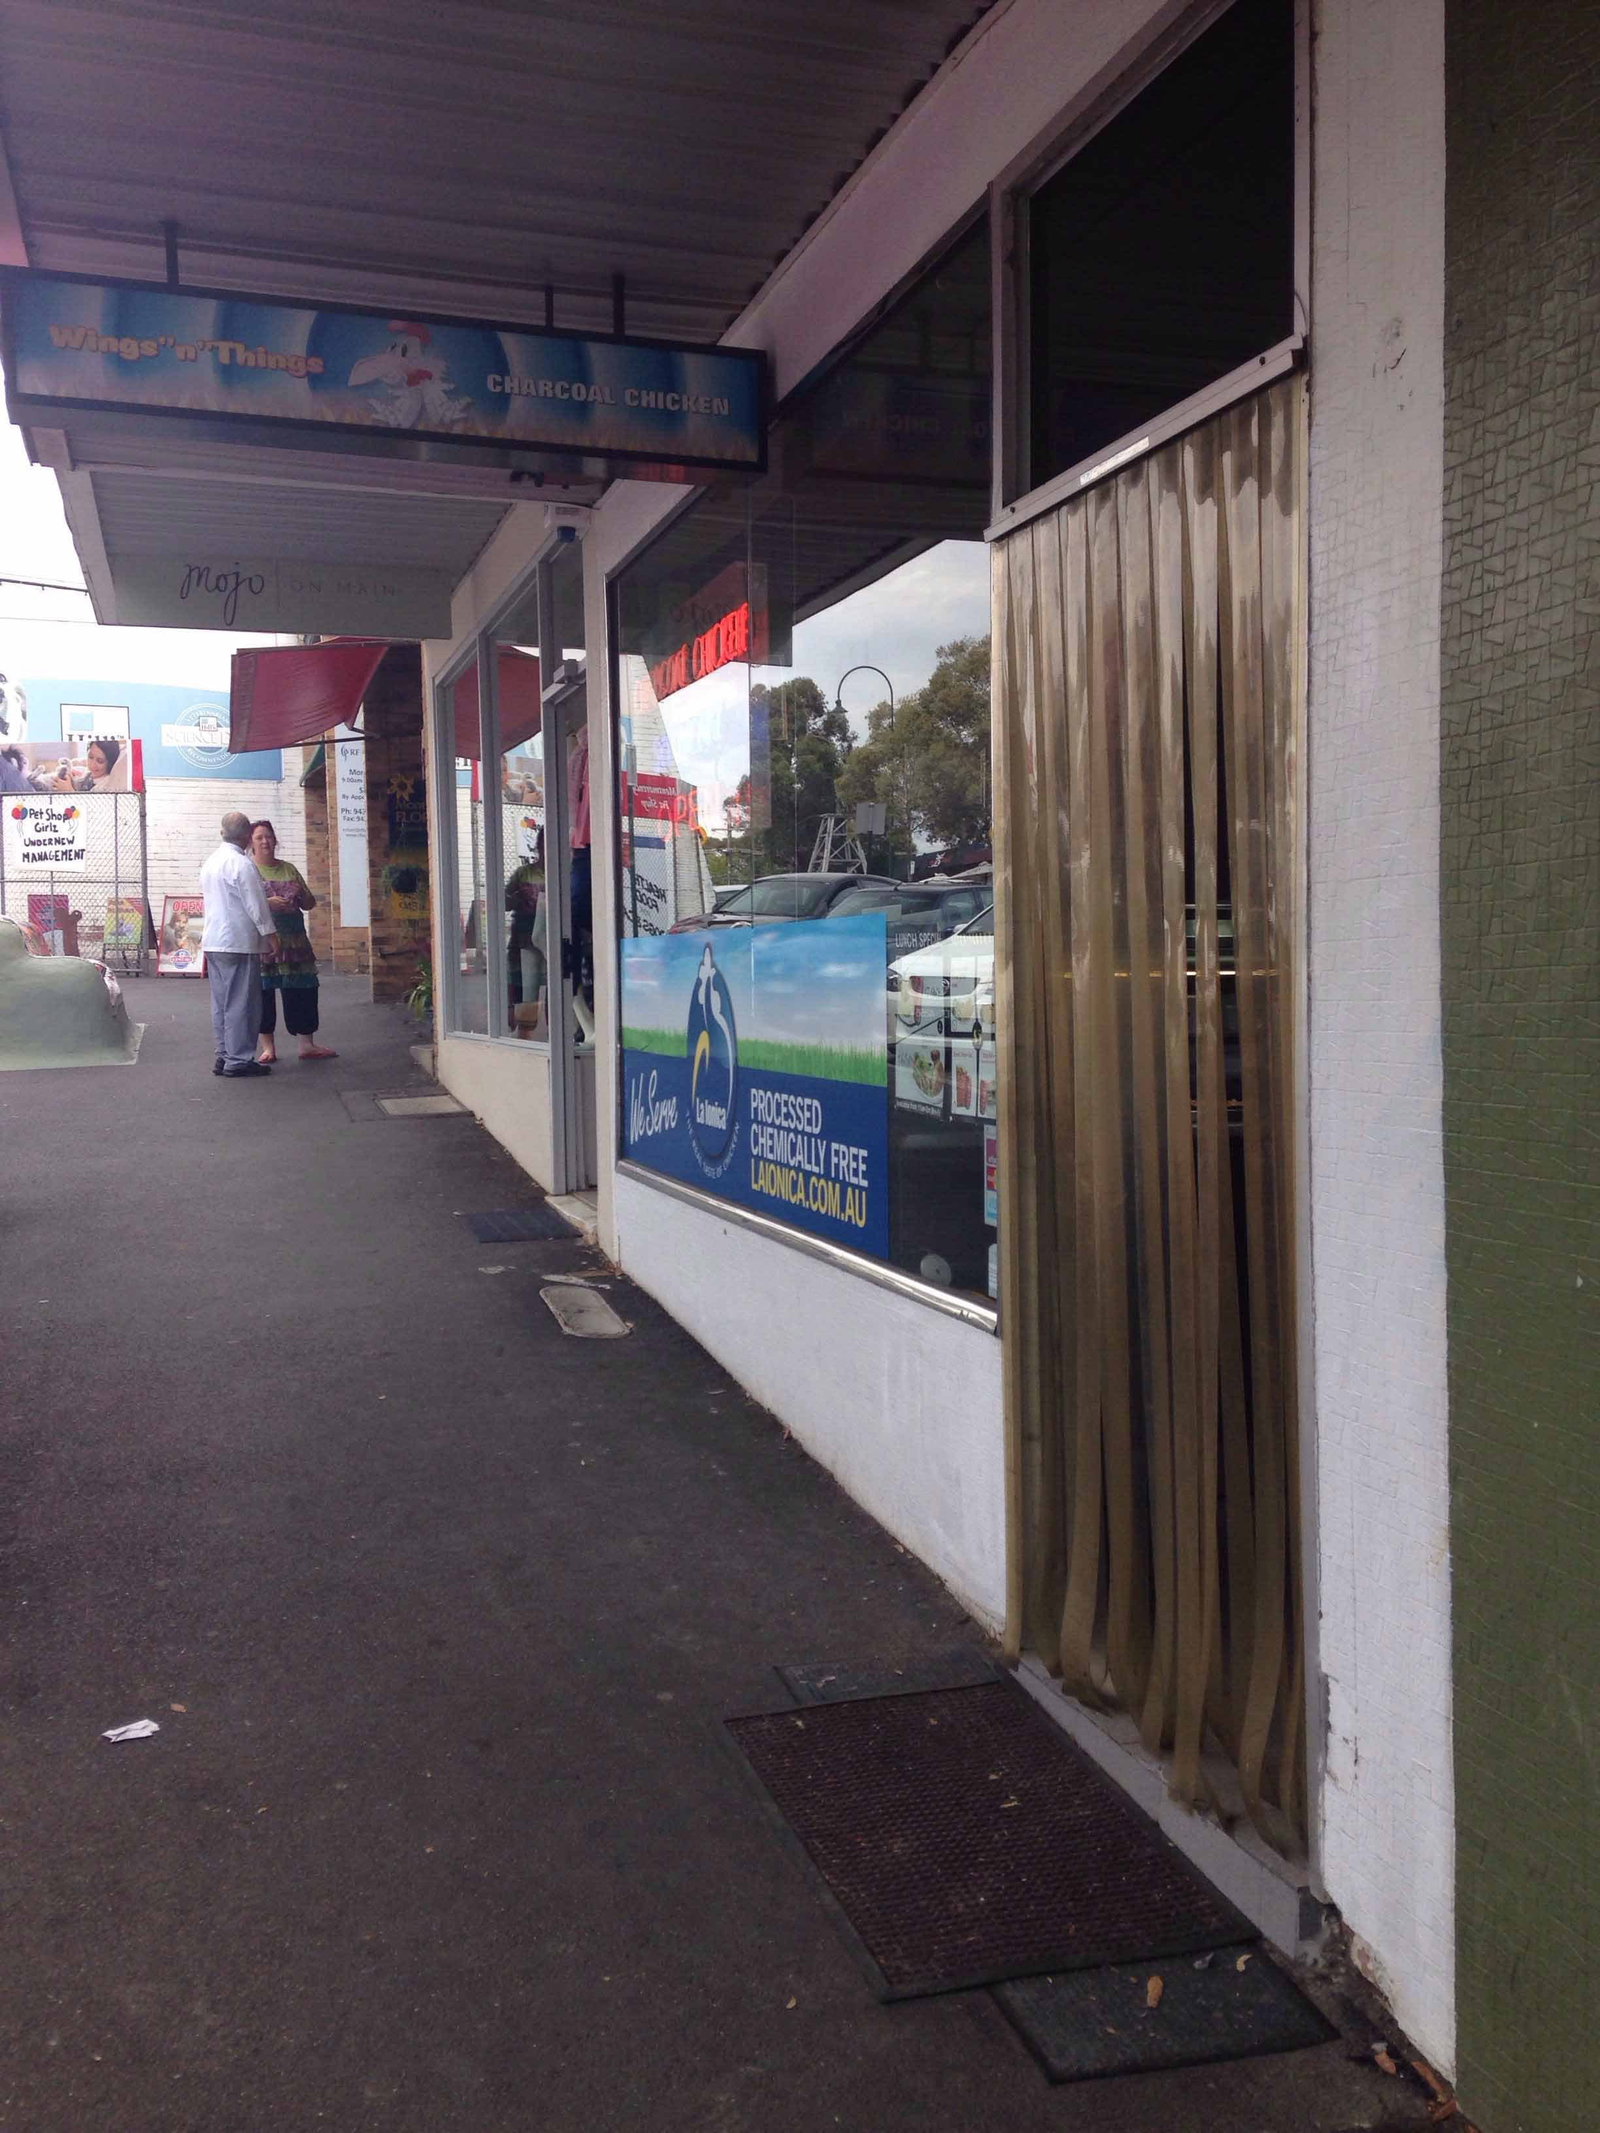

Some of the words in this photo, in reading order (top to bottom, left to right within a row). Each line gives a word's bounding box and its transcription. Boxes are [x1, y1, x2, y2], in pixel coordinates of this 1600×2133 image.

[487, 374, 616, 405] CHARCOAL
[624, 388, 731, 416] CHICKEN
[29, 808, 44, 819] Pet
[45, 808, 69, 823] Shop
[34, 822, 59, 833] Girlz
[22, 849, 86, 863] MANAGEMENT
[629, 1073, 645, 1144] We
[646, 1069, 678, 1136] Serve
[750, 1088, 822, 1135] PROCESSED
[750, 1124, 826, 1175] CHEMICALLY
[831, 1142, 869, 1187] FREE
[751, 1159, 867, 1228] LAIONICA.COM.AU
